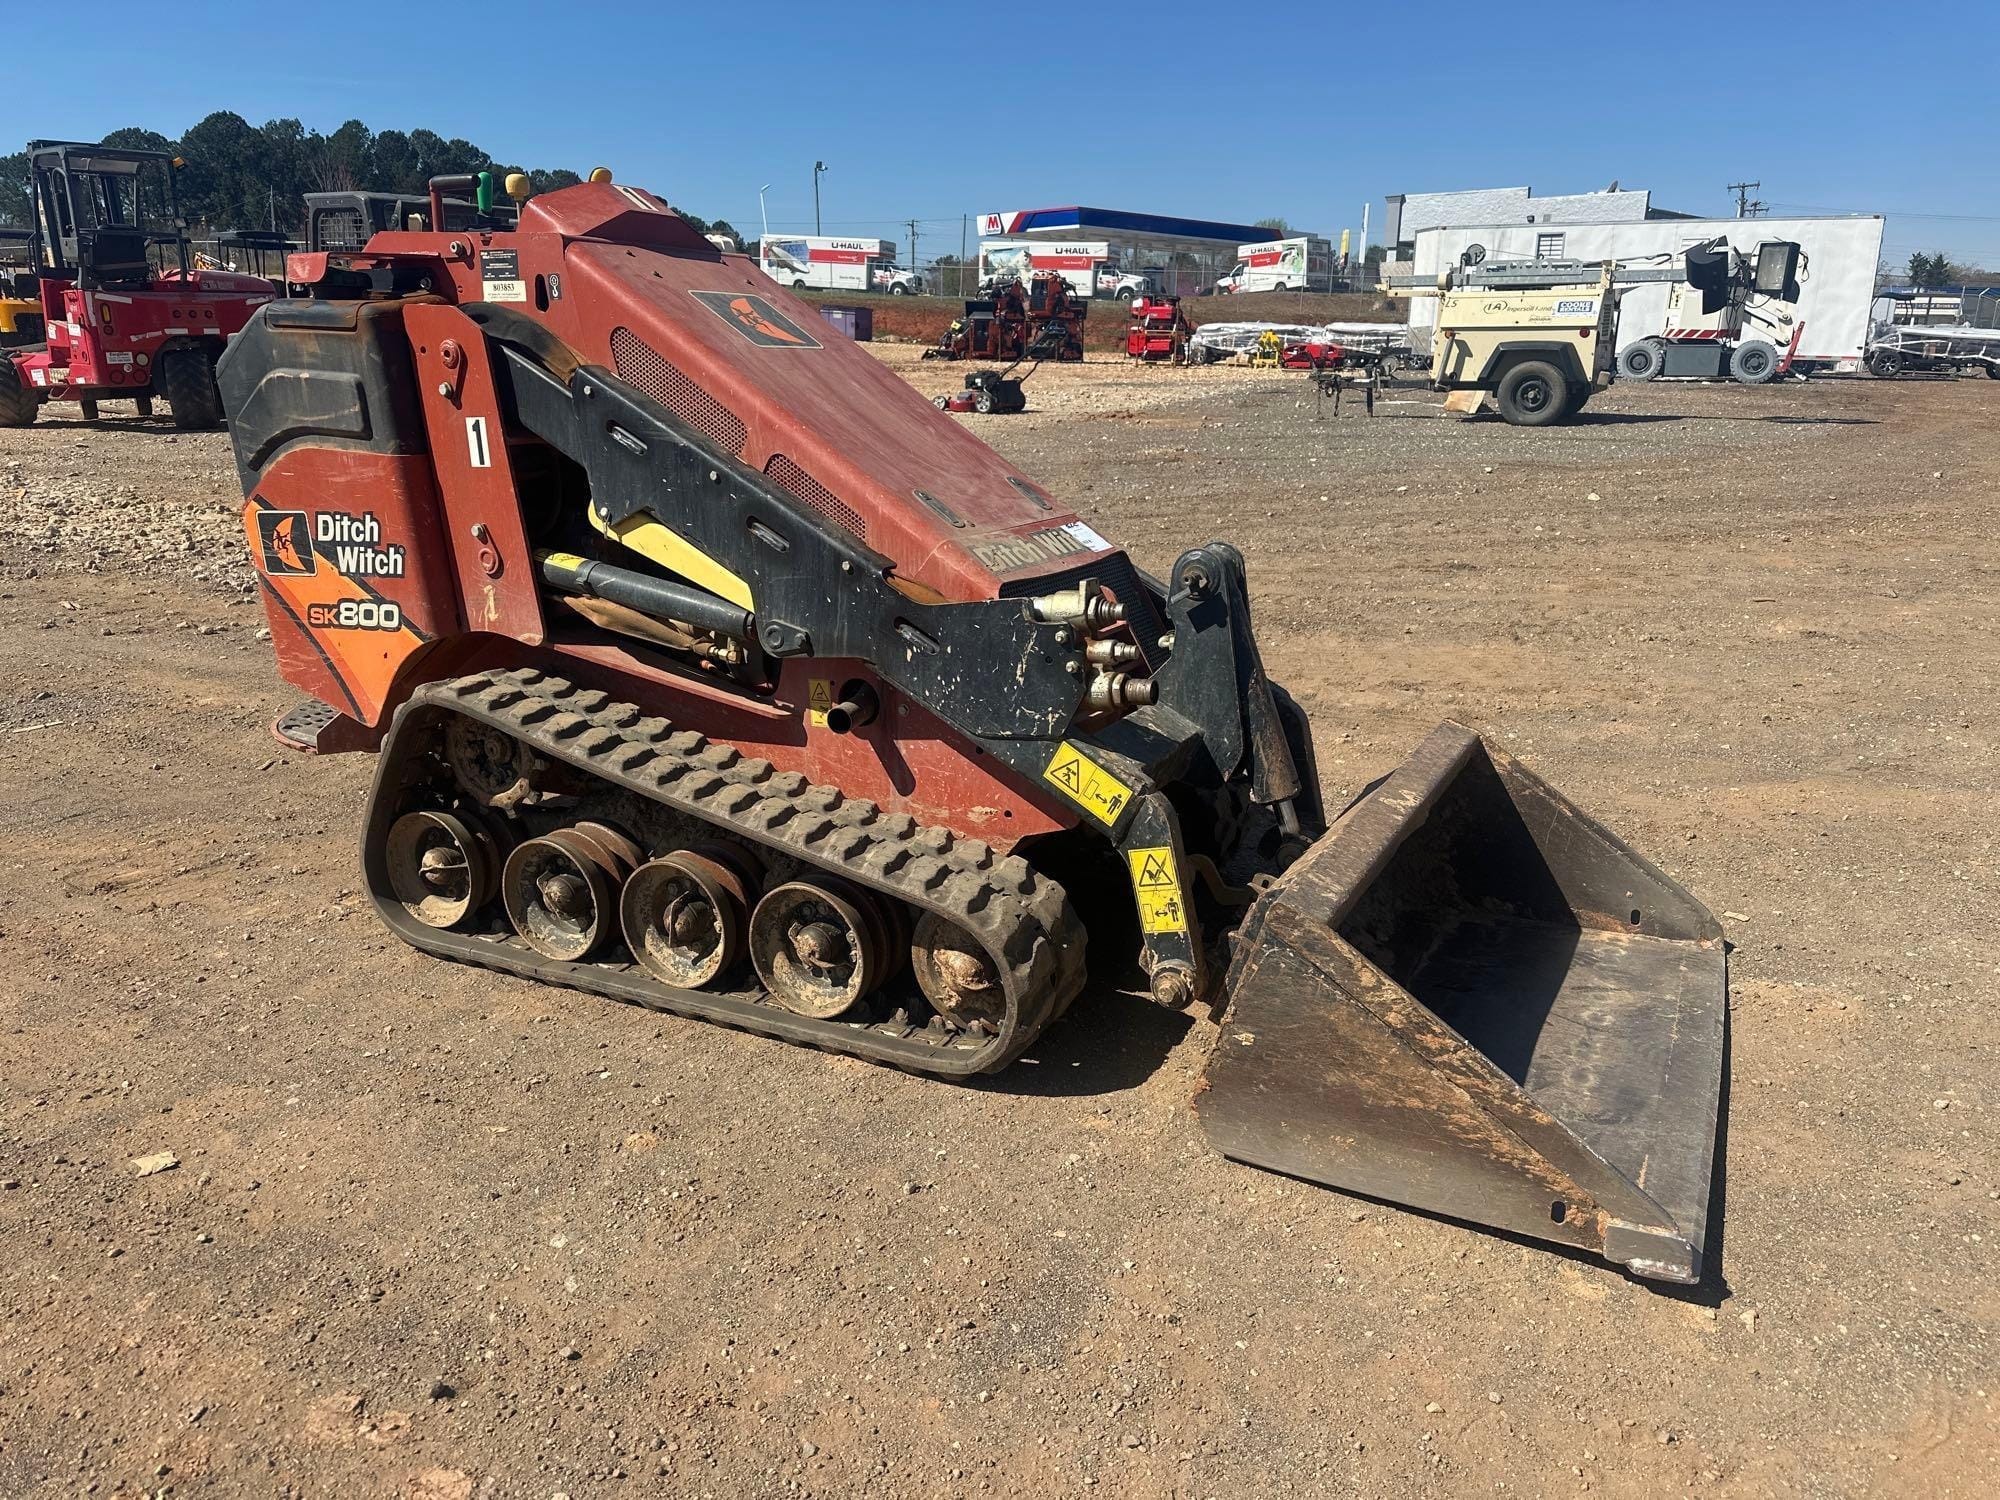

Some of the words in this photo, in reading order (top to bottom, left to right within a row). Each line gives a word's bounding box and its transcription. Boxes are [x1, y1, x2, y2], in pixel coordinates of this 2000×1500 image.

[988, 215, 999, 229] M
[831, 242, 864, 250] U-HAUL
[1250, 246, 1276, 254] U-HAUL
[472, 419, 485, 466] 1
[317, 514, 379, 542] Ditch
[336, 546, 403, 575] Witch
[973, 539, 1048, 572] Ditch
[1032, 530, 1082, 556] Wit
[310, 602, 400, 628] SK800
